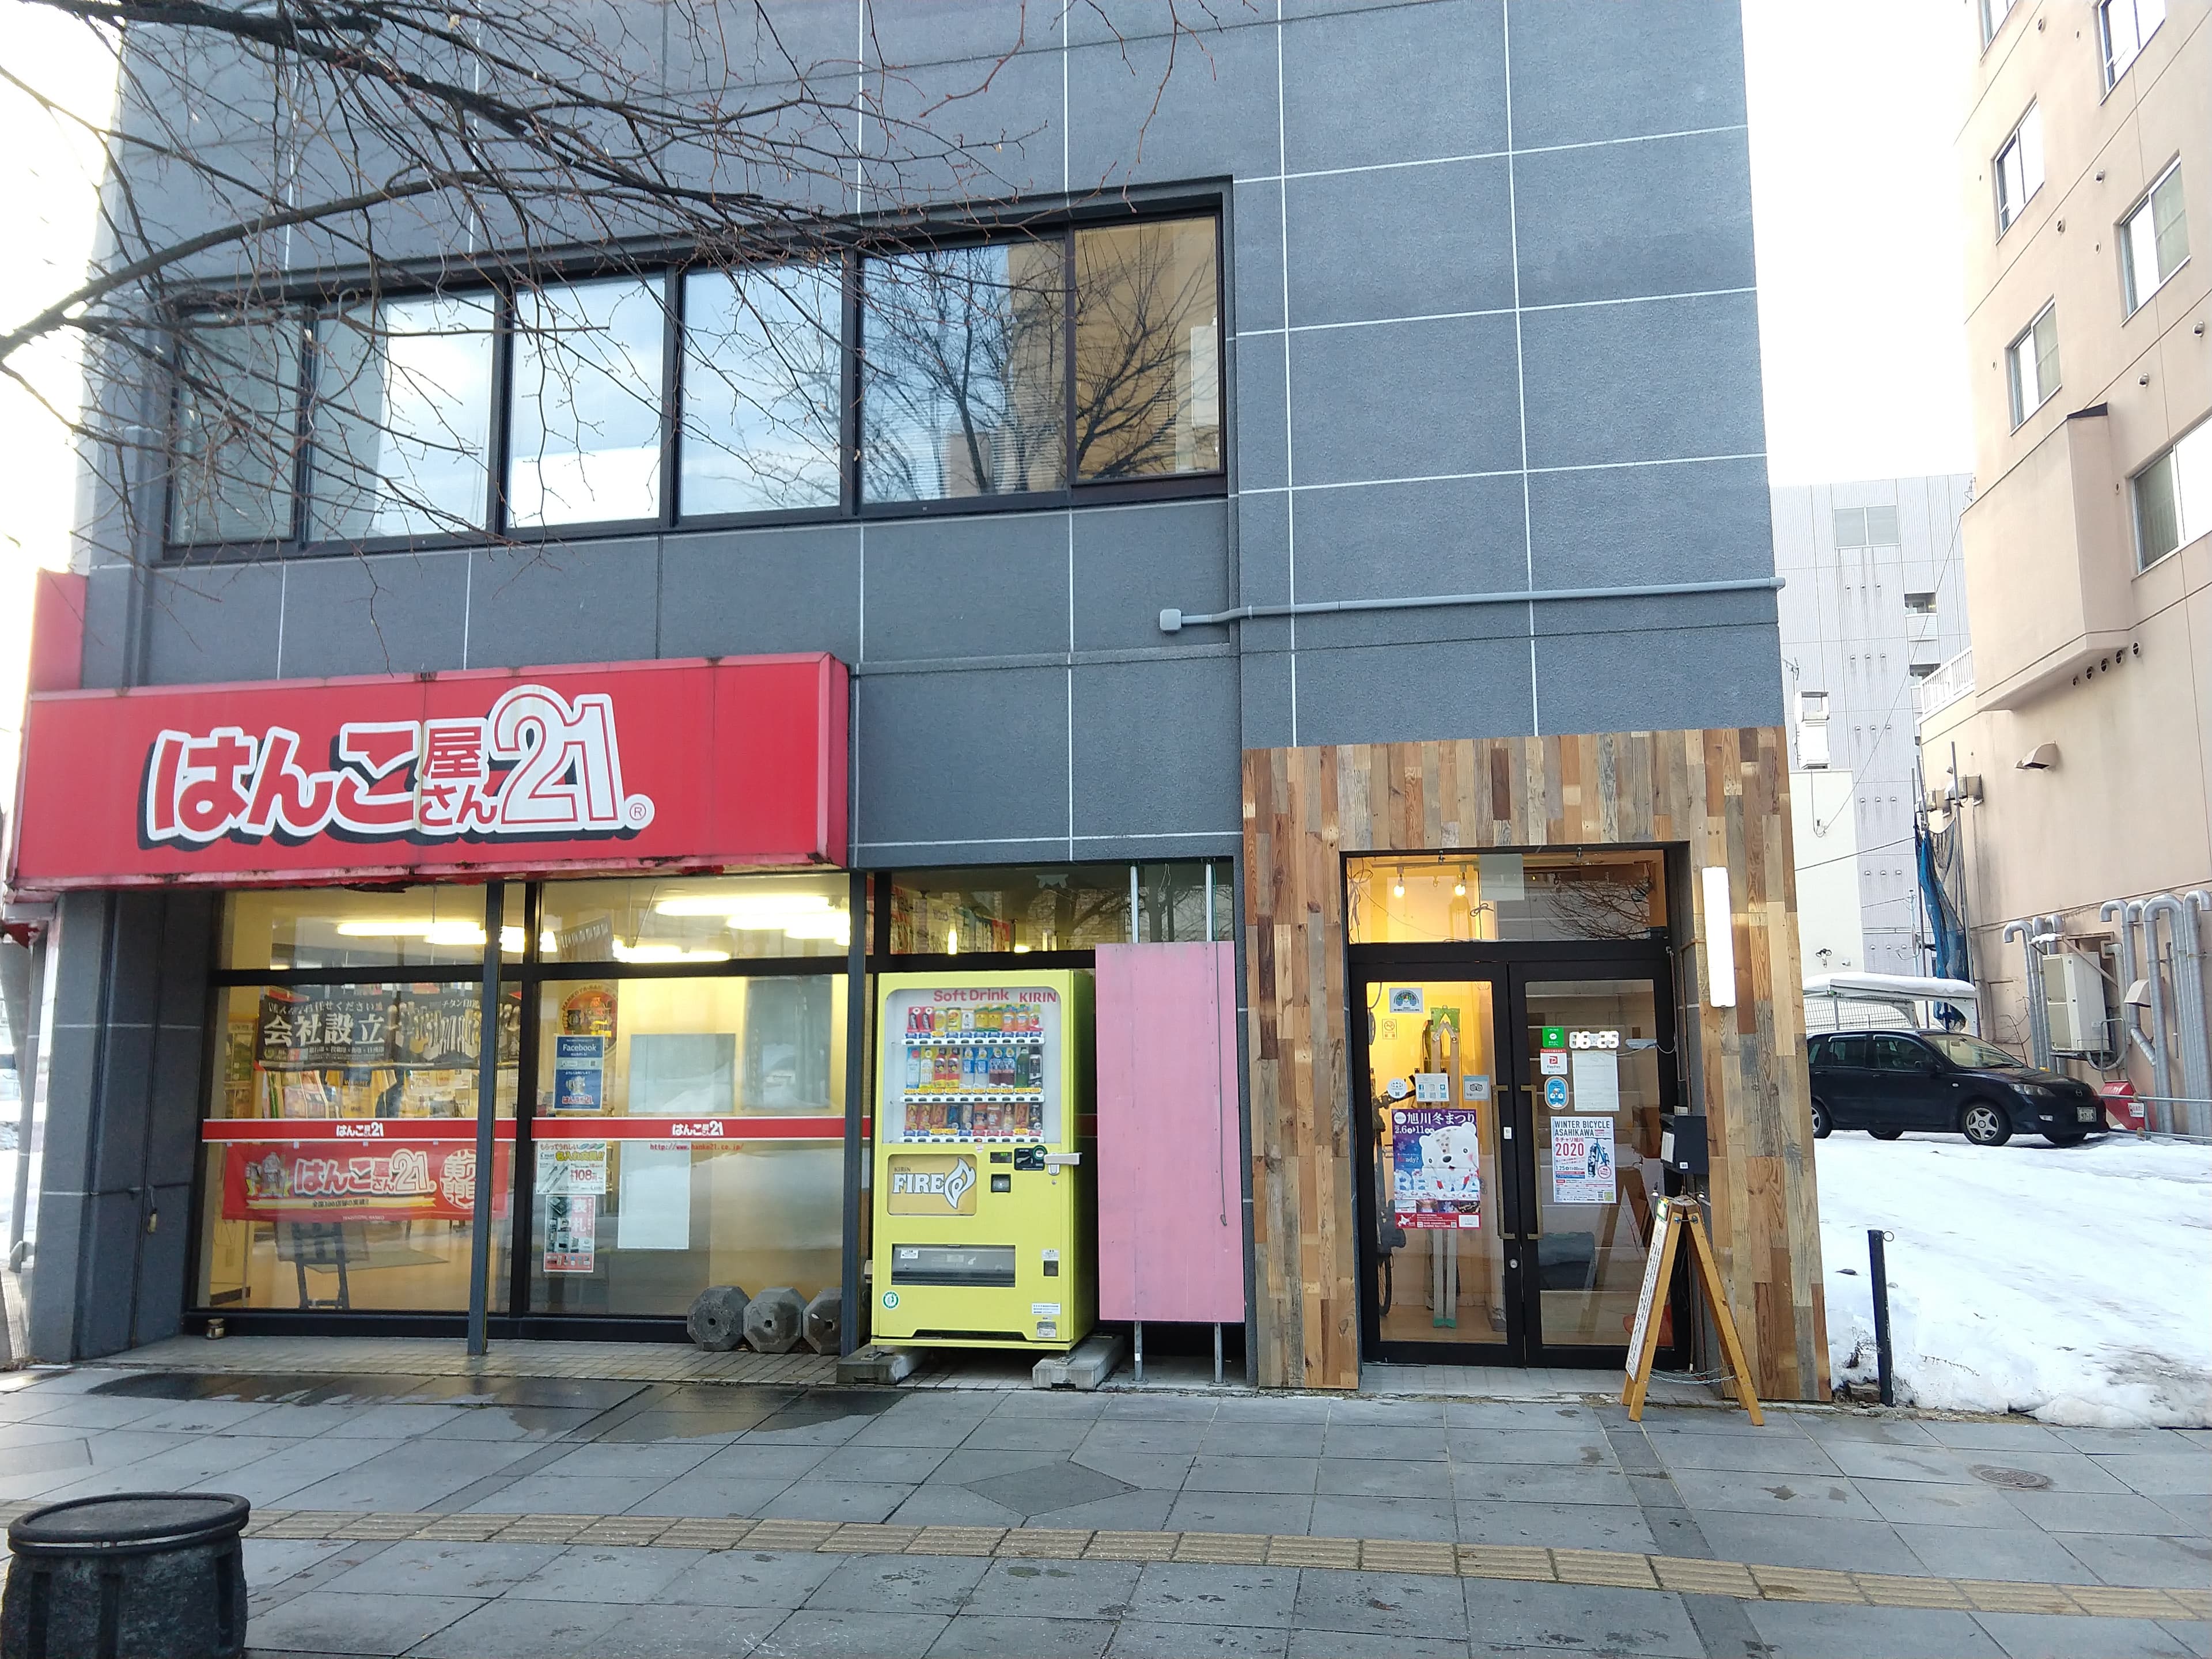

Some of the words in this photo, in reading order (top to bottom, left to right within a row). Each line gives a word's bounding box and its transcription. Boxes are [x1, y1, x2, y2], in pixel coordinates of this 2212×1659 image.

[145, 684, 623, 841] はんこ屋さん21
[933, 989, 967, 1002] Soft
[969, 988, 1009, 1002] Drink
[1019, 991, 1057, 1003] KIRIN
[264, 1013, 385, 1047] 会社設立
[563, 1043, 597, 1052] Facebook
[1407, 1112, 1475, 1125] 旭川冬まつり
[1555, 1120, 1580, 1128] WINTER
[1582, 1120, 1610, 1128] BICYCLE
[672, 1120, 724, 1137] はんこ屋さん21
[1555, 1143, 1584, 1156] 2020
[892, 1172, 945, 1195] FIRE
